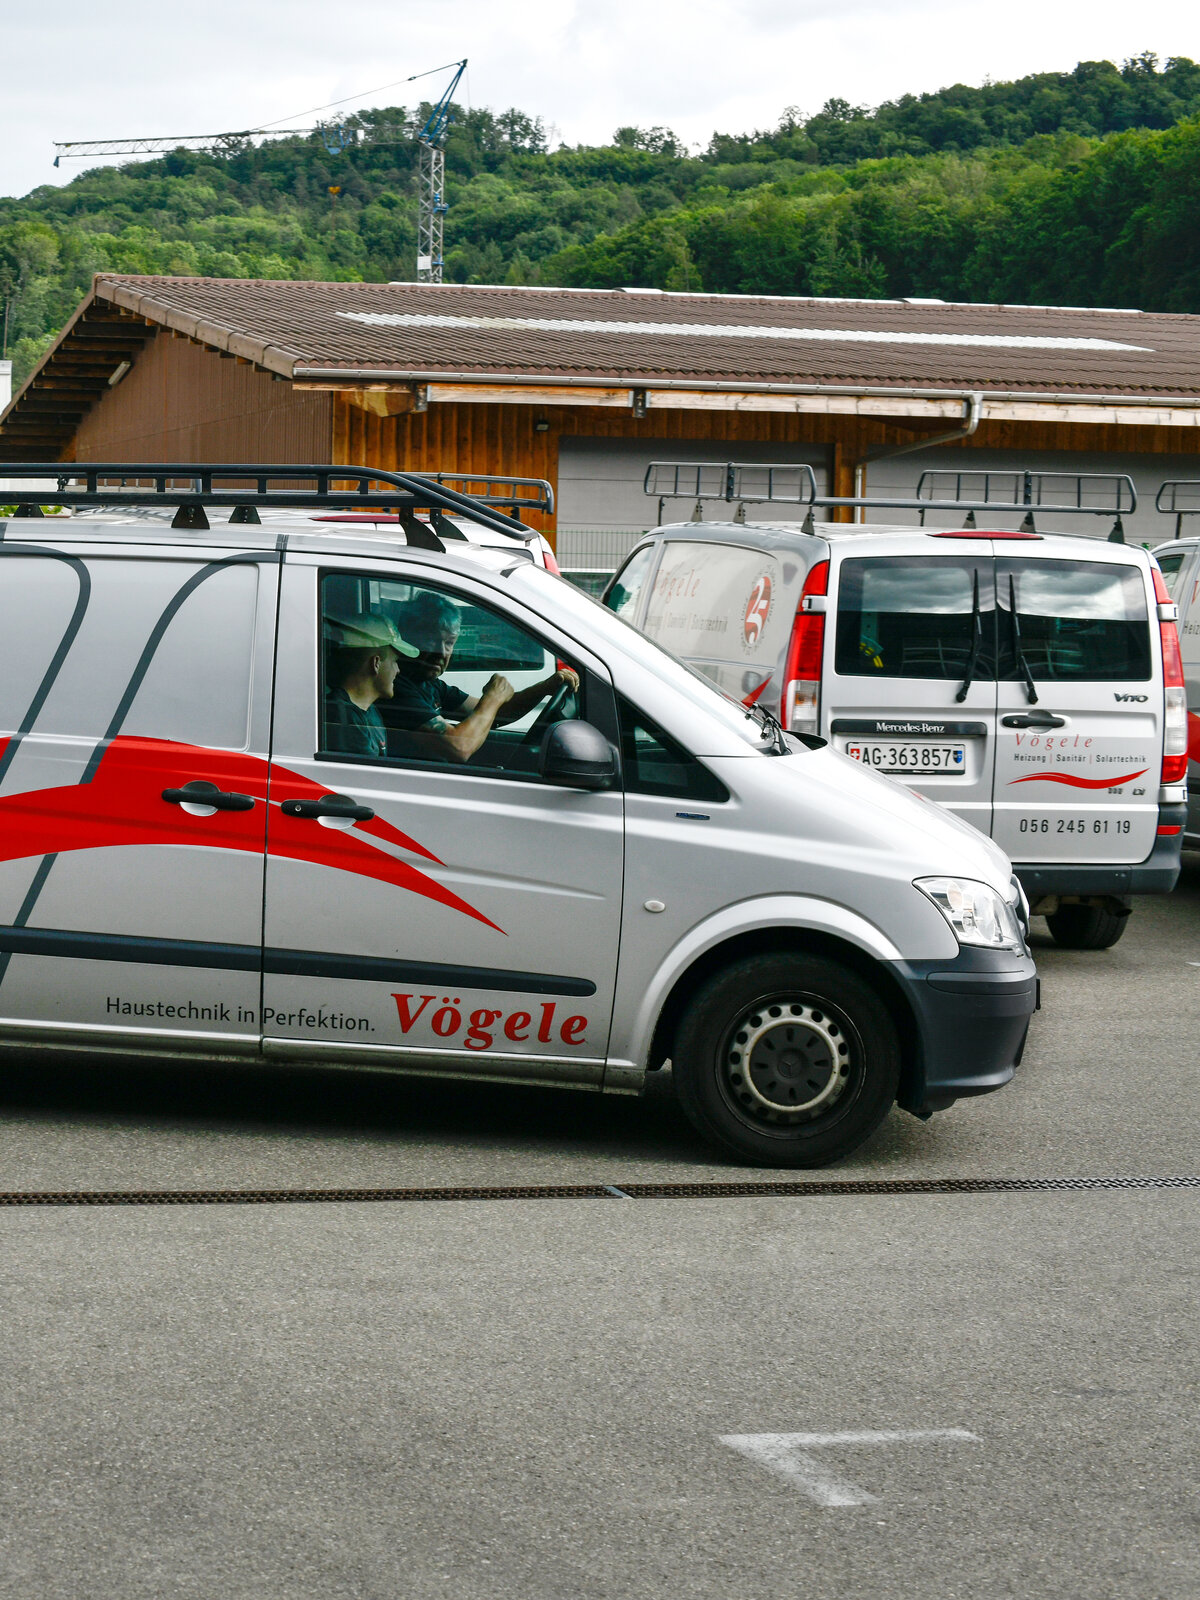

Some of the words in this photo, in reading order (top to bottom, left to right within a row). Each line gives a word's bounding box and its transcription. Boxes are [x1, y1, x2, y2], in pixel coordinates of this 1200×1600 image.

[876, 722, 945, 733] Mercedes-Benz
[1015, 732, 1093, 750] Vögele
[1013, 753, 1046, 763] Heizung
[1055, 753, 1086, 762] Sanitär
[1095, 754, 1147, 763] Solartechnik
[1019, 818, 1049, 833] 056
[1056, 819, 1085, 833] 245
[1093, 820, 1108, 834] 61
[1116, 820, 1131, 834] 19
[106, 997, 231, 1022] Haustechnik
[237, 1006, 255, 1023] in
[262, 1007, 376, 1032] Perfektion.
[390, 993, 588, 1050] Vögele
